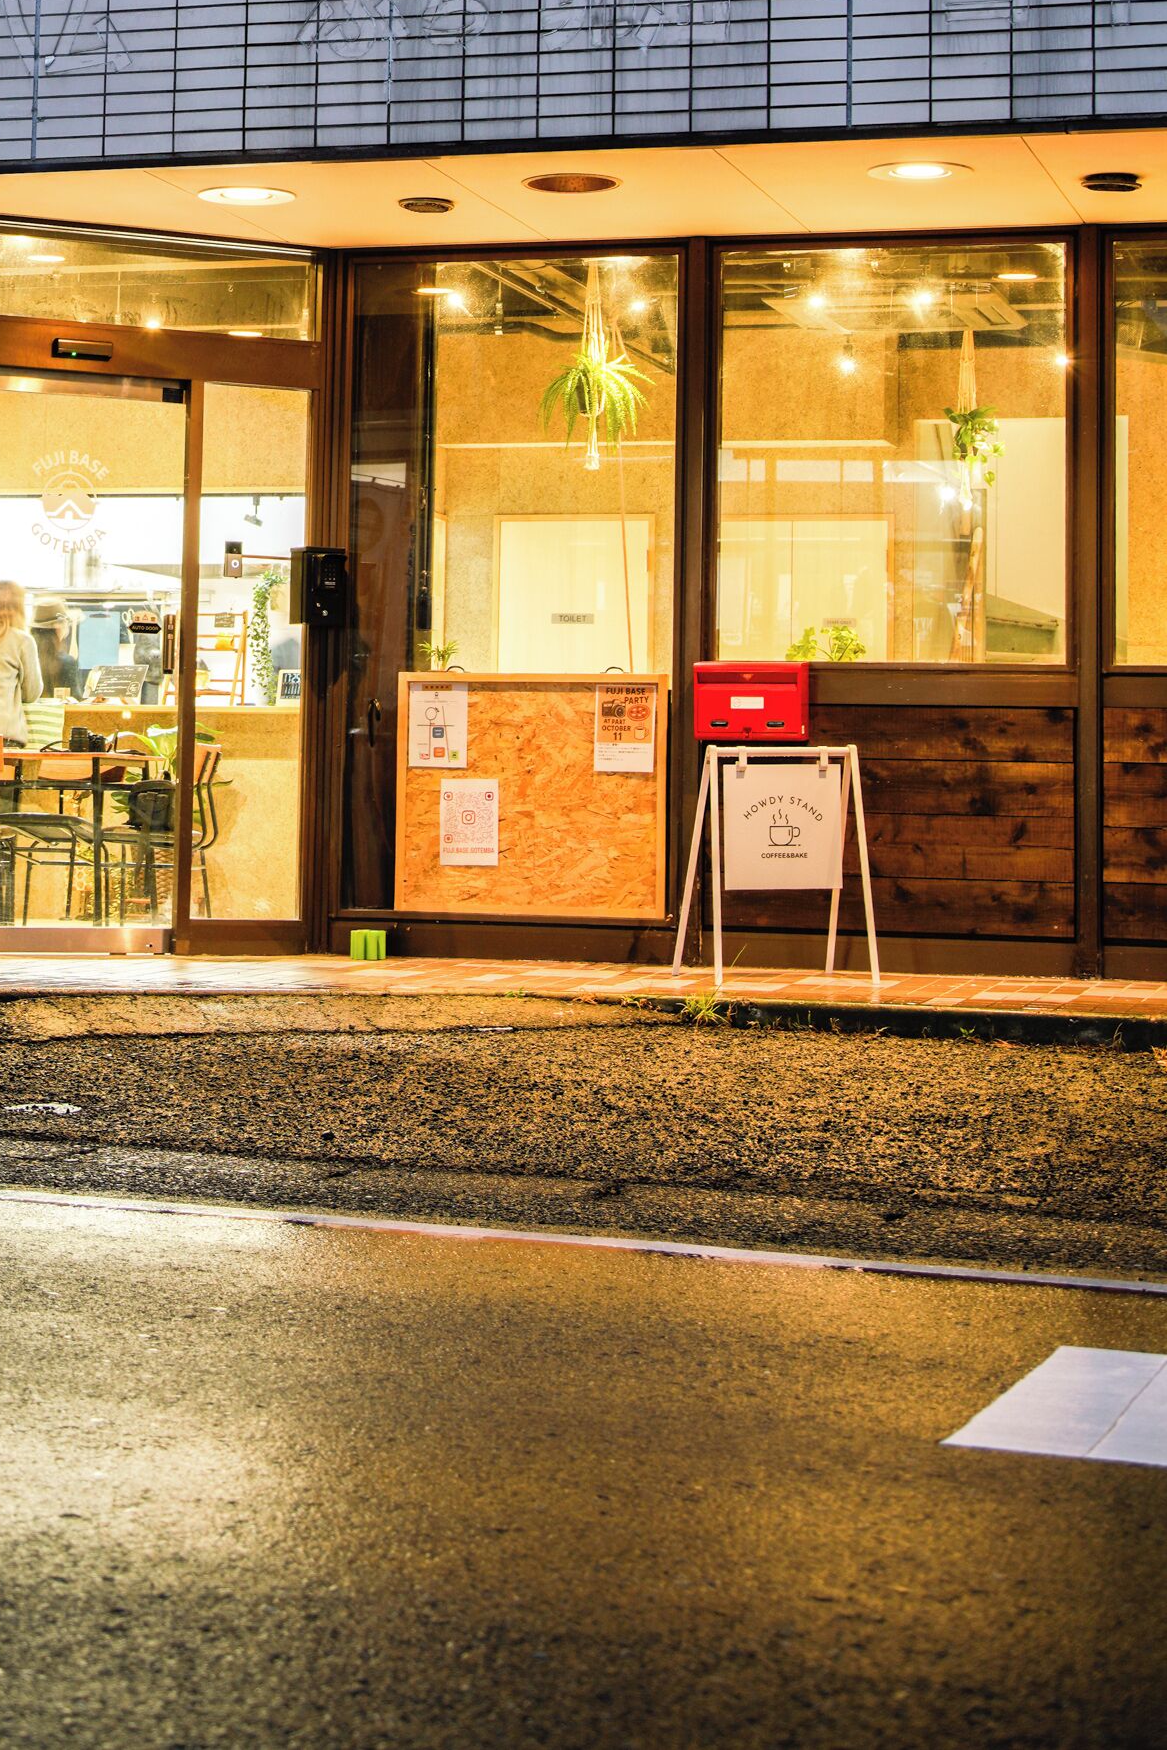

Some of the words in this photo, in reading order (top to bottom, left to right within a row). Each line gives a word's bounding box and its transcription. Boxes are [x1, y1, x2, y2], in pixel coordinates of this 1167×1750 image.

[32, 451, 65, 477] FUJI
[69, 450, 110, 480] BASE
[31, 522, 108, 554] GOTEMBA
[559, 614, 587, 623] TOILET
[606, 687, 623, 695] FUJI
[625, 687, 646, 696] BASE
[624, 696, 649, 705] PARTY
[601, 724, 632, 732] OCTOBER
[613, 732, 622, 741] 11
[743, 795, 784, 820] HOWDY
[789, 796, 823, 822] STAND
